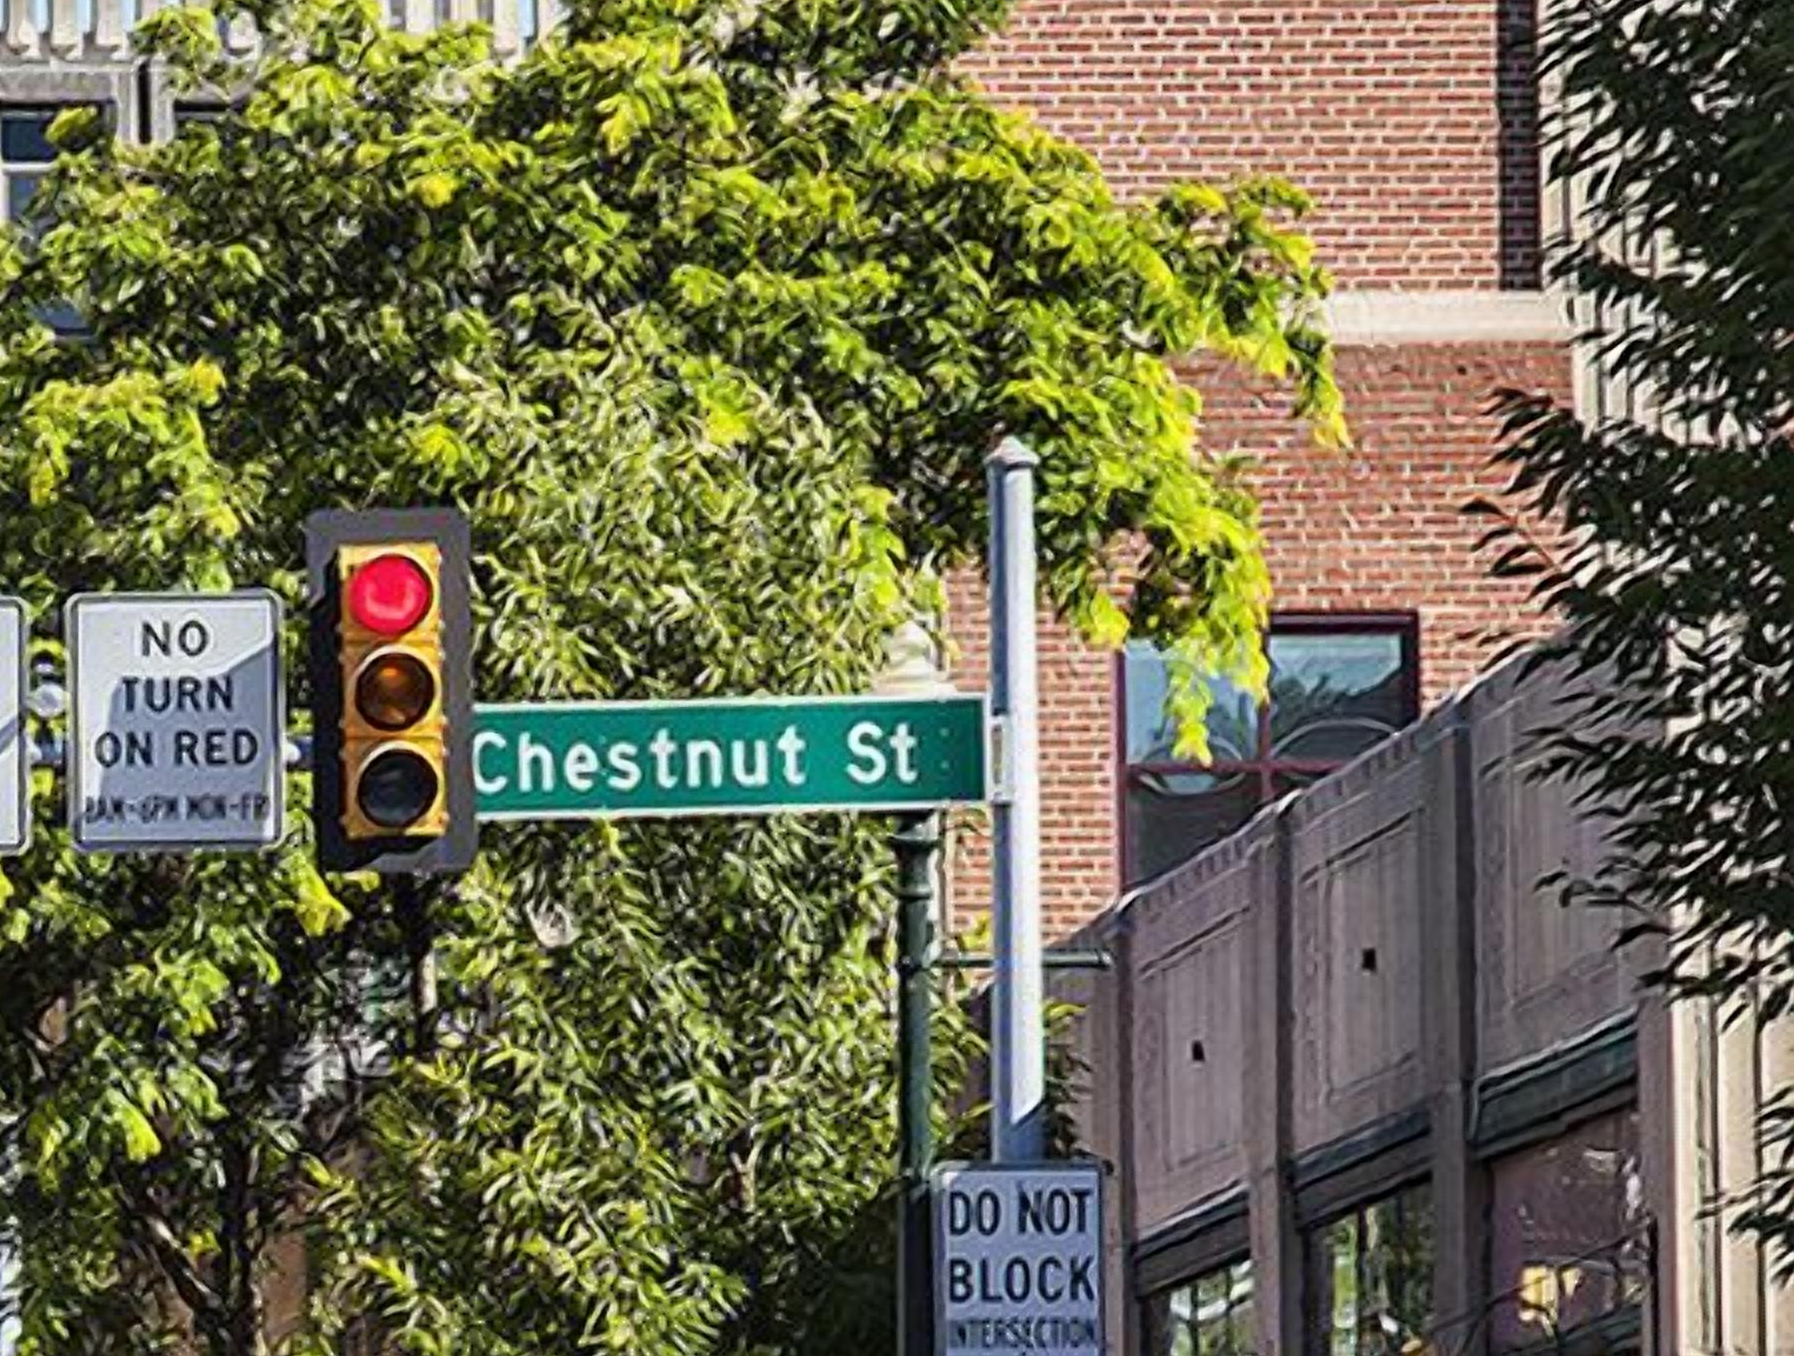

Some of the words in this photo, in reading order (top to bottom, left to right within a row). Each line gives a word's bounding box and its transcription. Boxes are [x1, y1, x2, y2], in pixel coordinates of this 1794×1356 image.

[141, 619, 209, 658] NO
[120, 675, 235, 714] TURN
[95, 729, 153, 769] ON
[174, 729, 259, 768] RED
[472, 725, 806, 794] Chestnut
[846, 720, 919, 784] St
[949, 1188, 1001, 1236] DO
[1017, 1187, 1093, 1236] NOT
[949, 1255, 1095, 1304] BLOCK
[949, 1316, 1095, 1349] INTERSECTION
